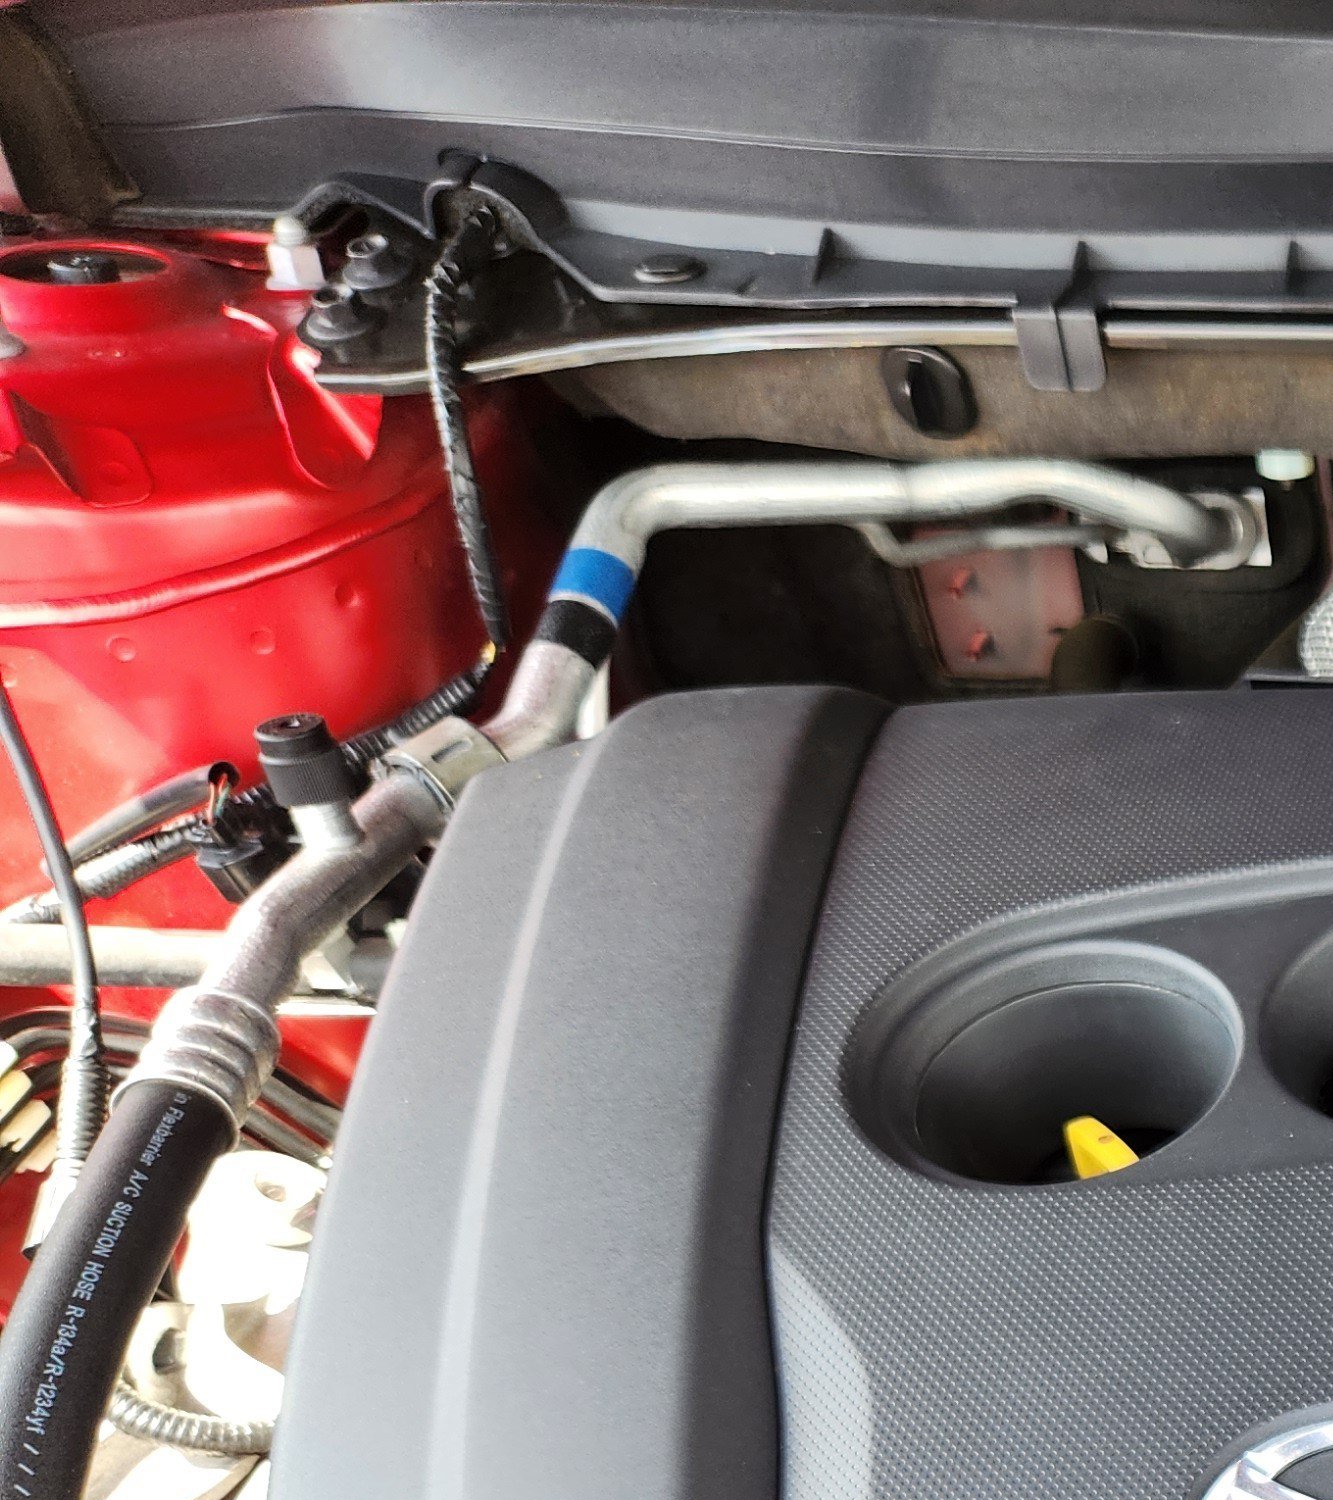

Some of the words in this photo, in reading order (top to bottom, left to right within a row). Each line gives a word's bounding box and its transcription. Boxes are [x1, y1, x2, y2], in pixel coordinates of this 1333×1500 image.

[139, 1106, 186, 1167] Flexbarrier
[123, 1168, 149, 1199] A/C
[92, 1200, 133, 1258] SUCTION
[72, 1257, 104, 1301] HOSE
[24, 1303, 87, 1436] R-134a/R-1234yf
